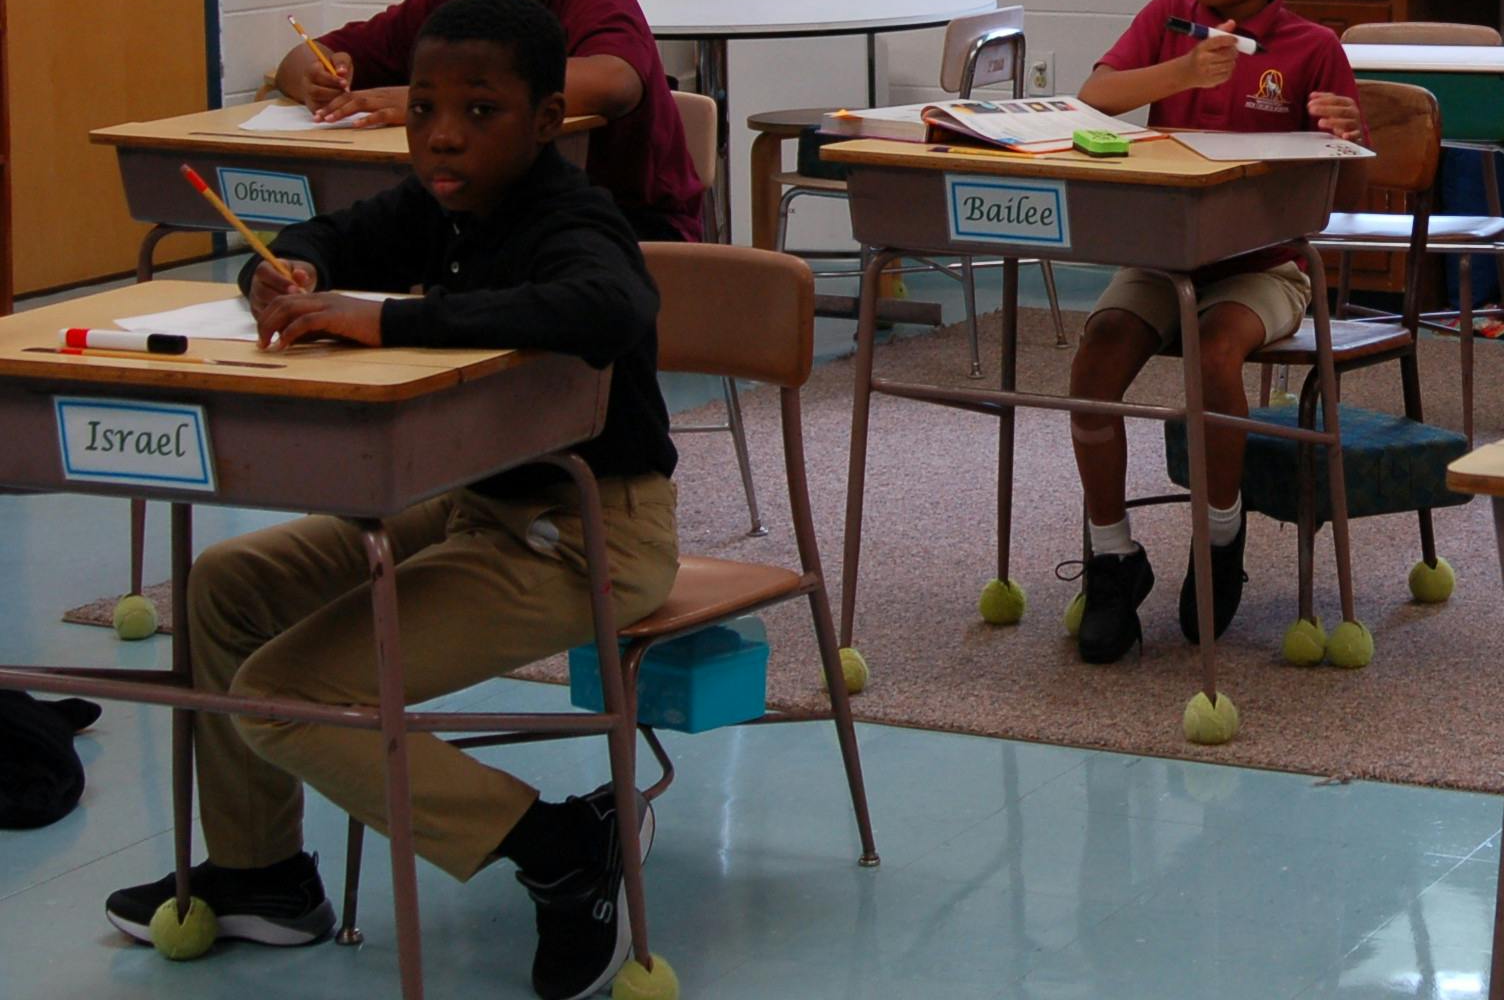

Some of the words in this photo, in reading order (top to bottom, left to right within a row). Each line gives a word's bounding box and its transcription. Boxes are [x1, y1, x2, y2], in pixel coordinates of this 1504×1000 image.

[234, 181, 304, 206] Obinna
[963, 196, 1054, 226] Bailee
[85, 421, 189, 457] Israel
